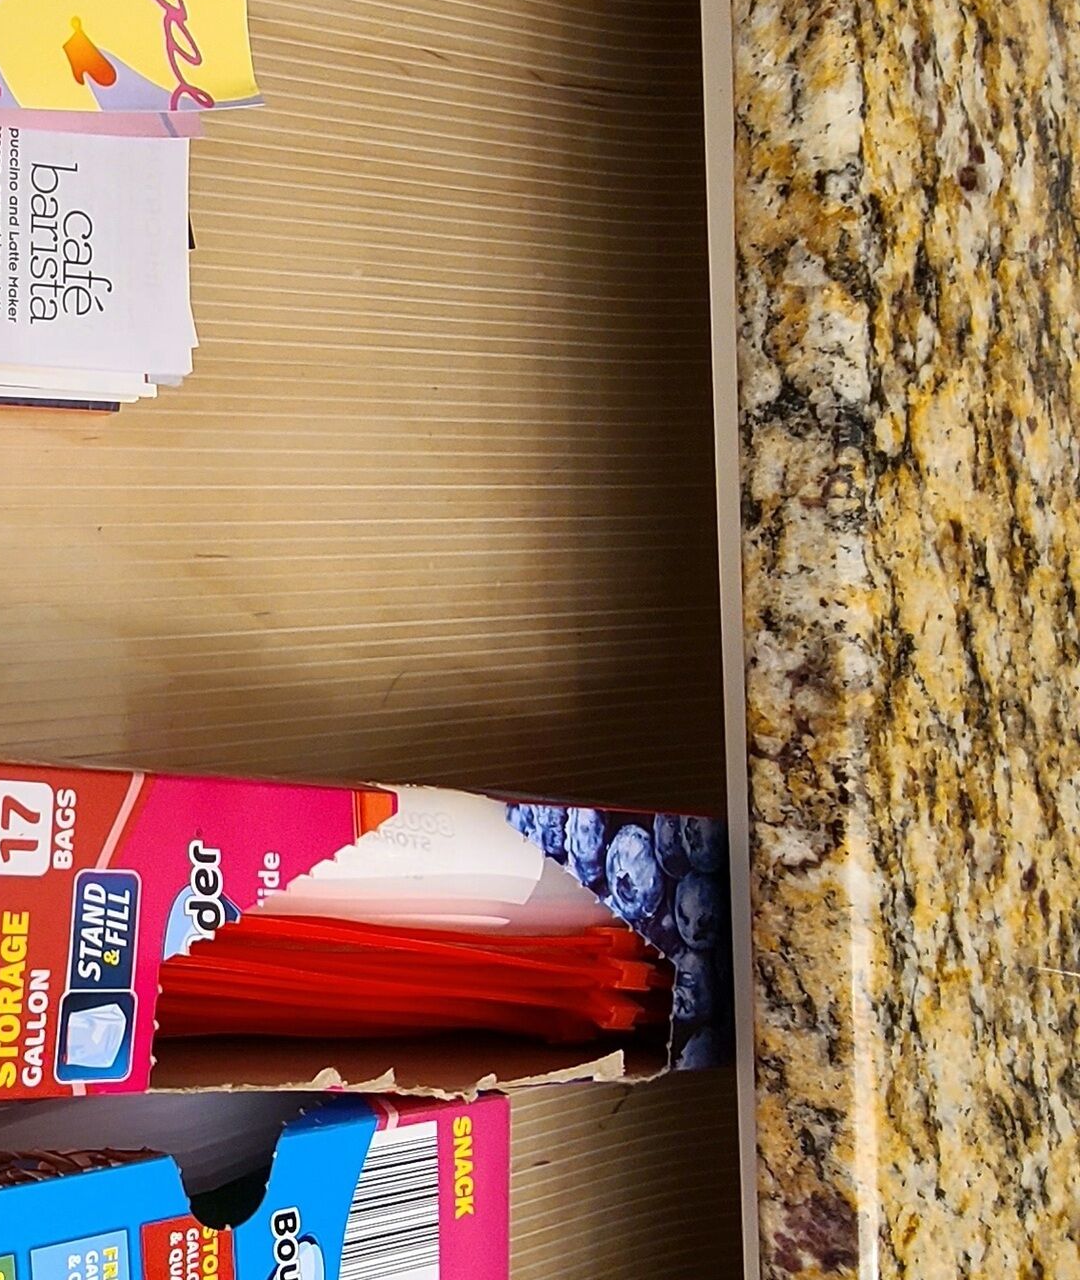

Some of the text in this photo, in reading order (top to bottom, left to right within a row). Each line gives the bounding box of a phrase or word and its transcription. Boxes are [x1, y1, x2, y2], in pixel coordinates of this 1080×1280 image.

[7, 230, 21, 272] Latte
[8, 195, 21, 227] and
[7, 276, 20, 324] Maker
[61, 209, 113, 317] café
[52, 788, 78, 871] BAGS
[103, 888, 132, 967] & FILL
[183, 839, 225, 938] der
[76, 881, 107, 982] STAND
[21, 968, 51, 1088] GALLON
[451, 1115, 476, 1220] SNACK
[66, 1253, 82, 1269] &
[169, 1230, 184, 1246] &
